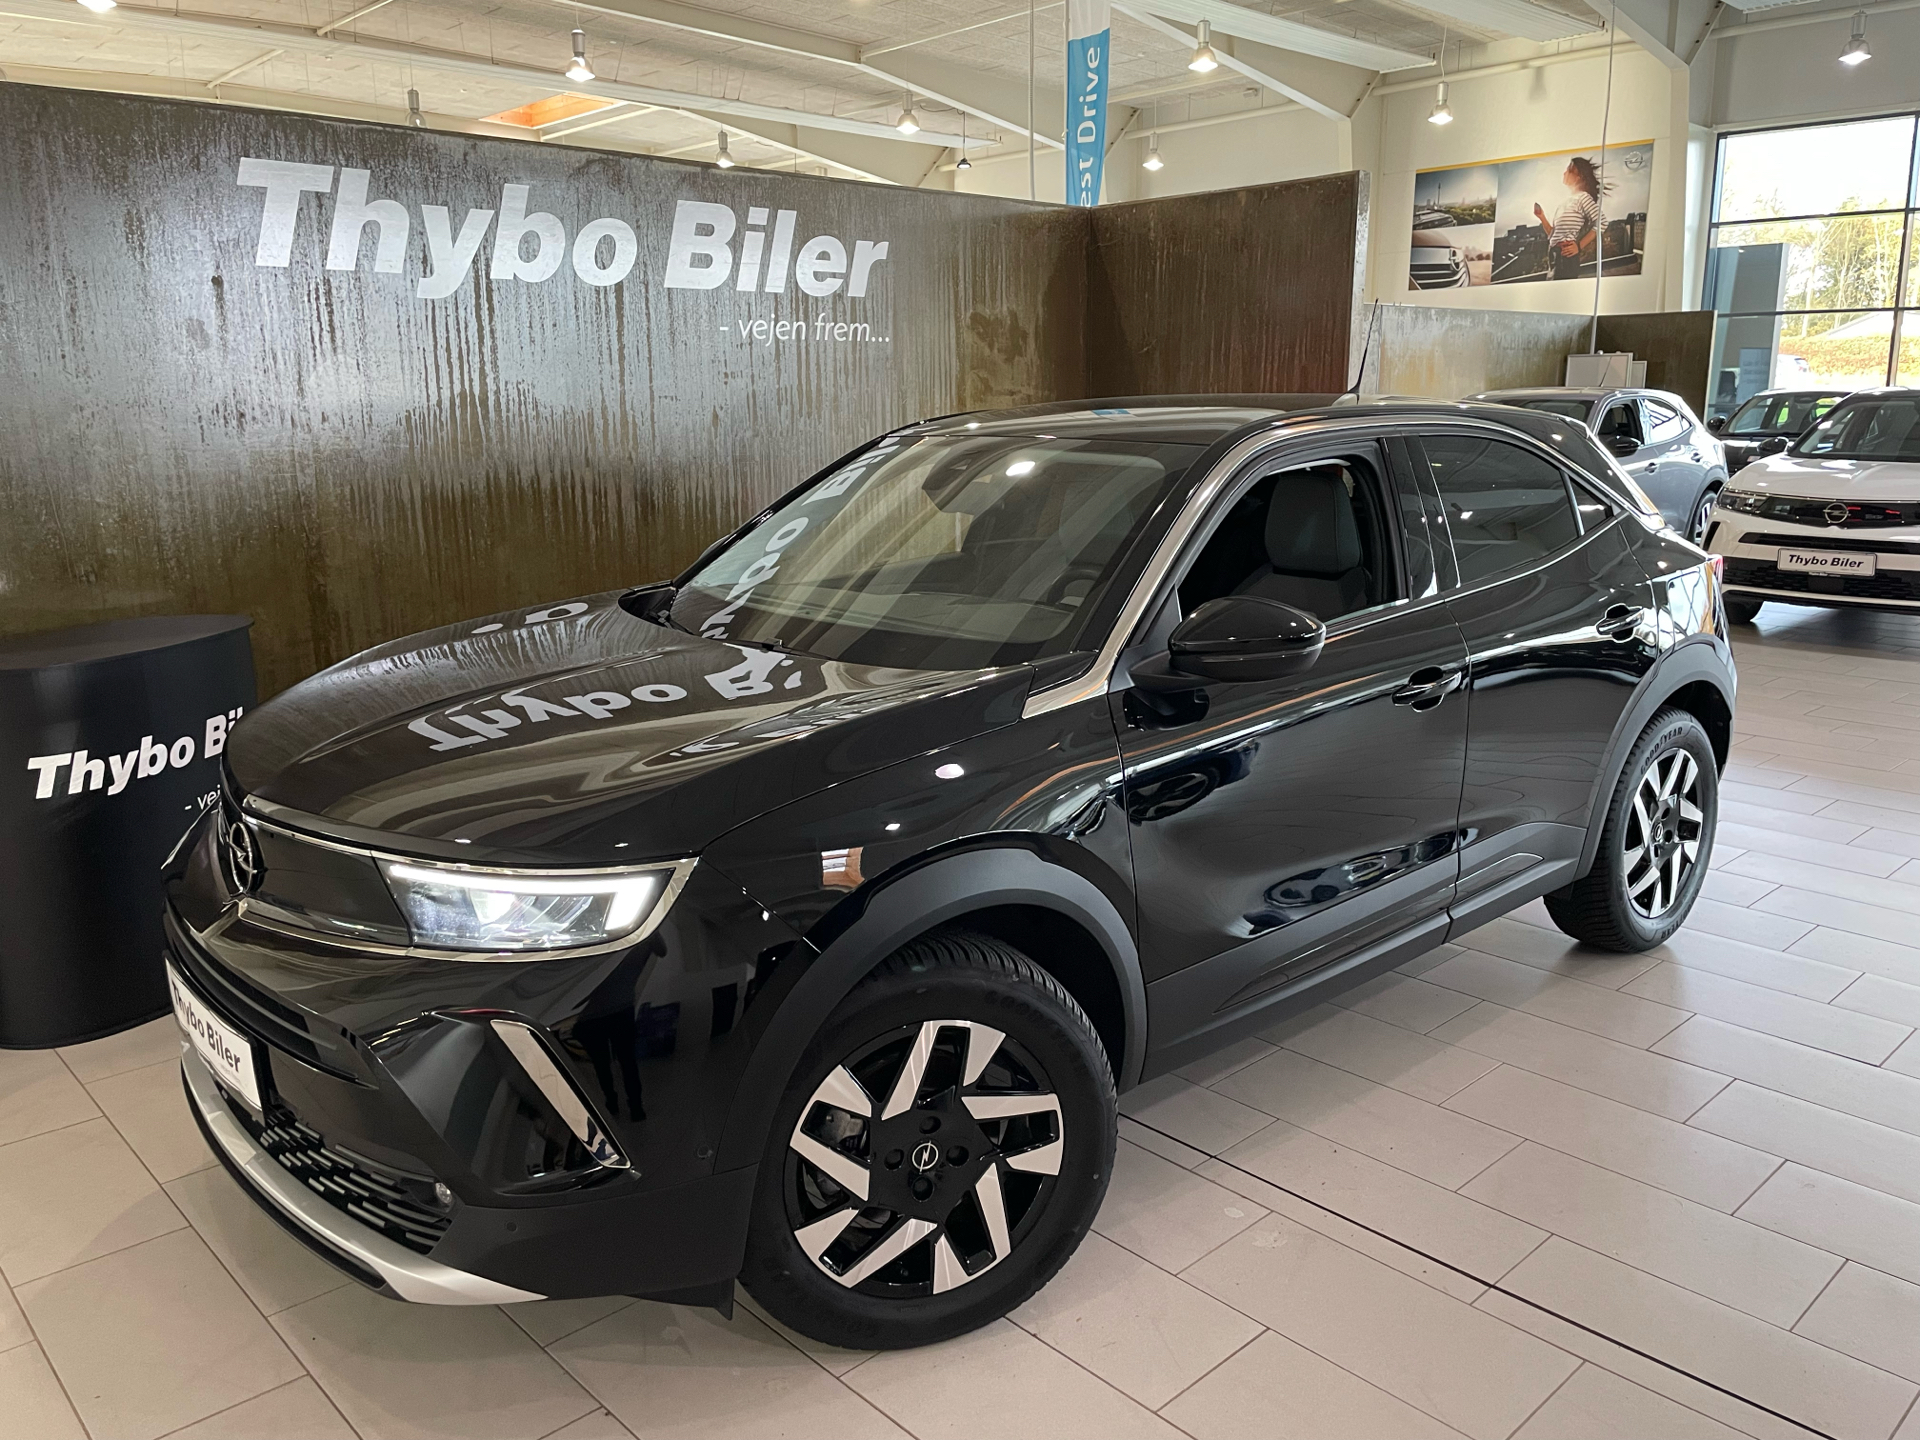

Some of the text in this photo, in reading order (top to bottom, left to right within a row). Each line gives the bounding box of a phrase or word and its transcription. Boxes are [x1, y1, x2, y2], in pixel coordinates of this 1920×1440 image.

[1077, 47, 1101, 143] Drive
[236, 156, 889, 298] Thybo Biler
[738, 313, 806, 347] vejen
[815, 313, 890, 342] frem...
[1788, 554, 1864, 568] Thybo Biler
[27, 706, 243, 799] Thybo Bi
[1640, 726, 1683, 775] GOODYEAR
[171, 979, 205, 1038] Thybo
[206, 1021, 241, 1073] Biler
